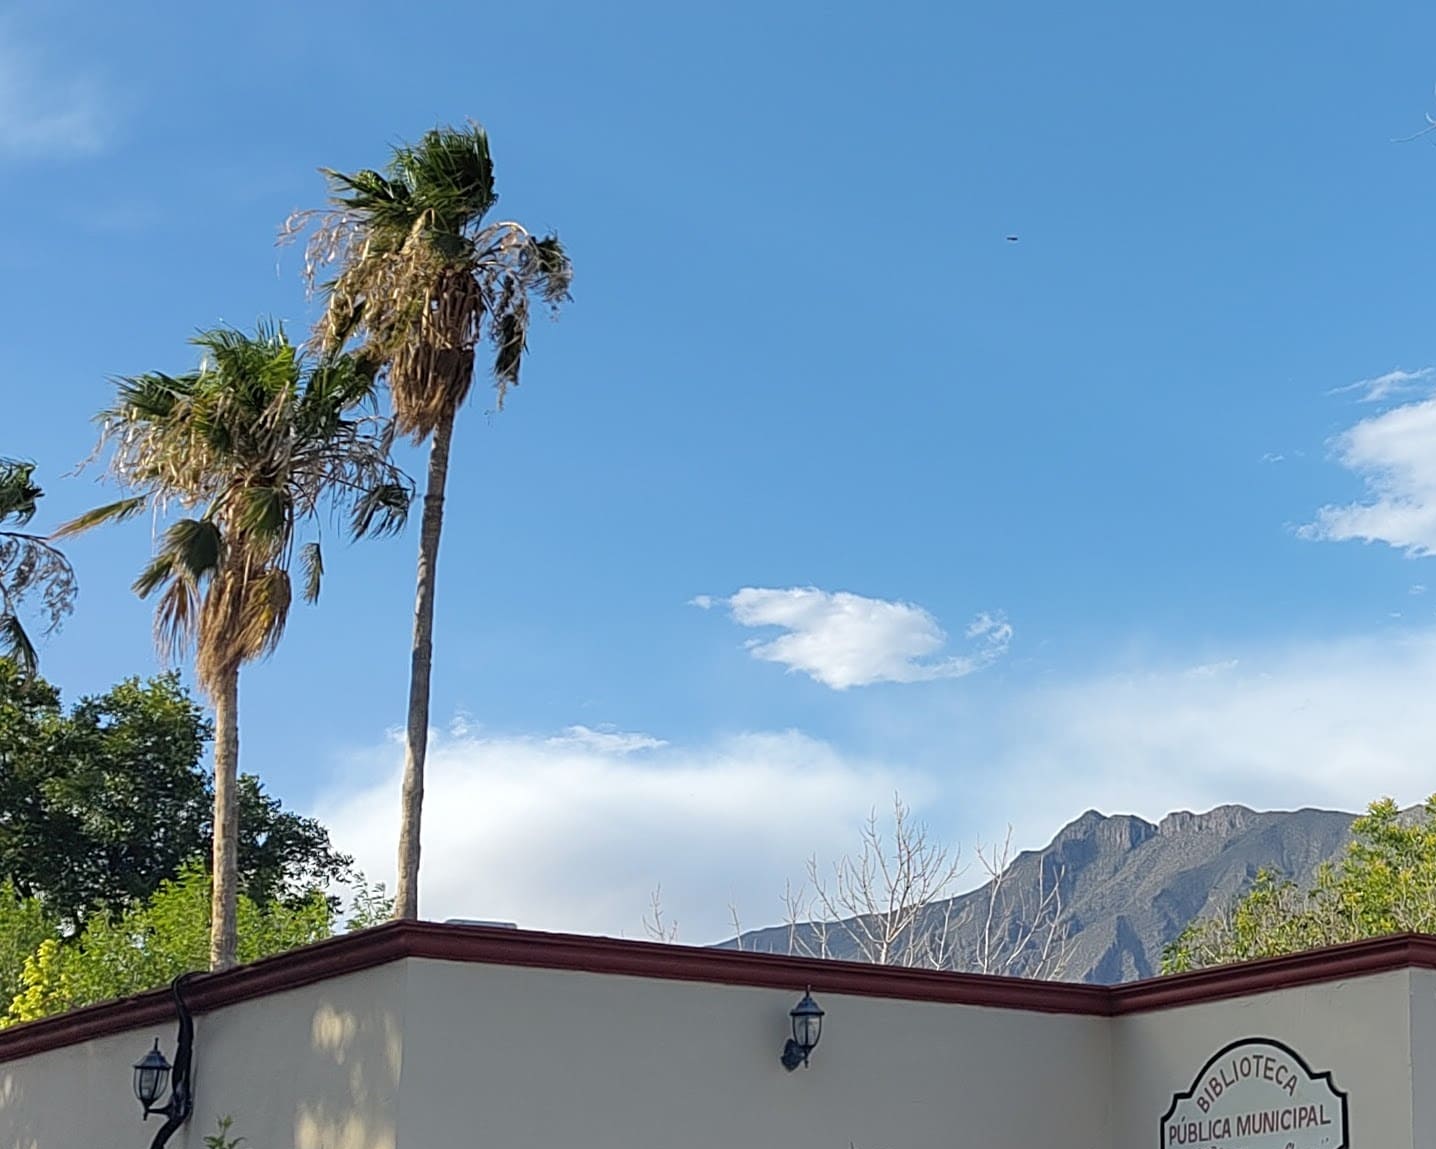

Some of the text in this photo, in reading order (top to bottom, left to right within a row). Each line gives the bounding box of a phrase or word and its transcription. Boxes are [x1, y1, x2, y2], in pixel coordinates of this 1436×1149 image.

[1197, 1055, 1298, 1114] BIBLIOTECA
[1169, 1104, 1331, 1146] PÚBLICA MUNICIPAL
